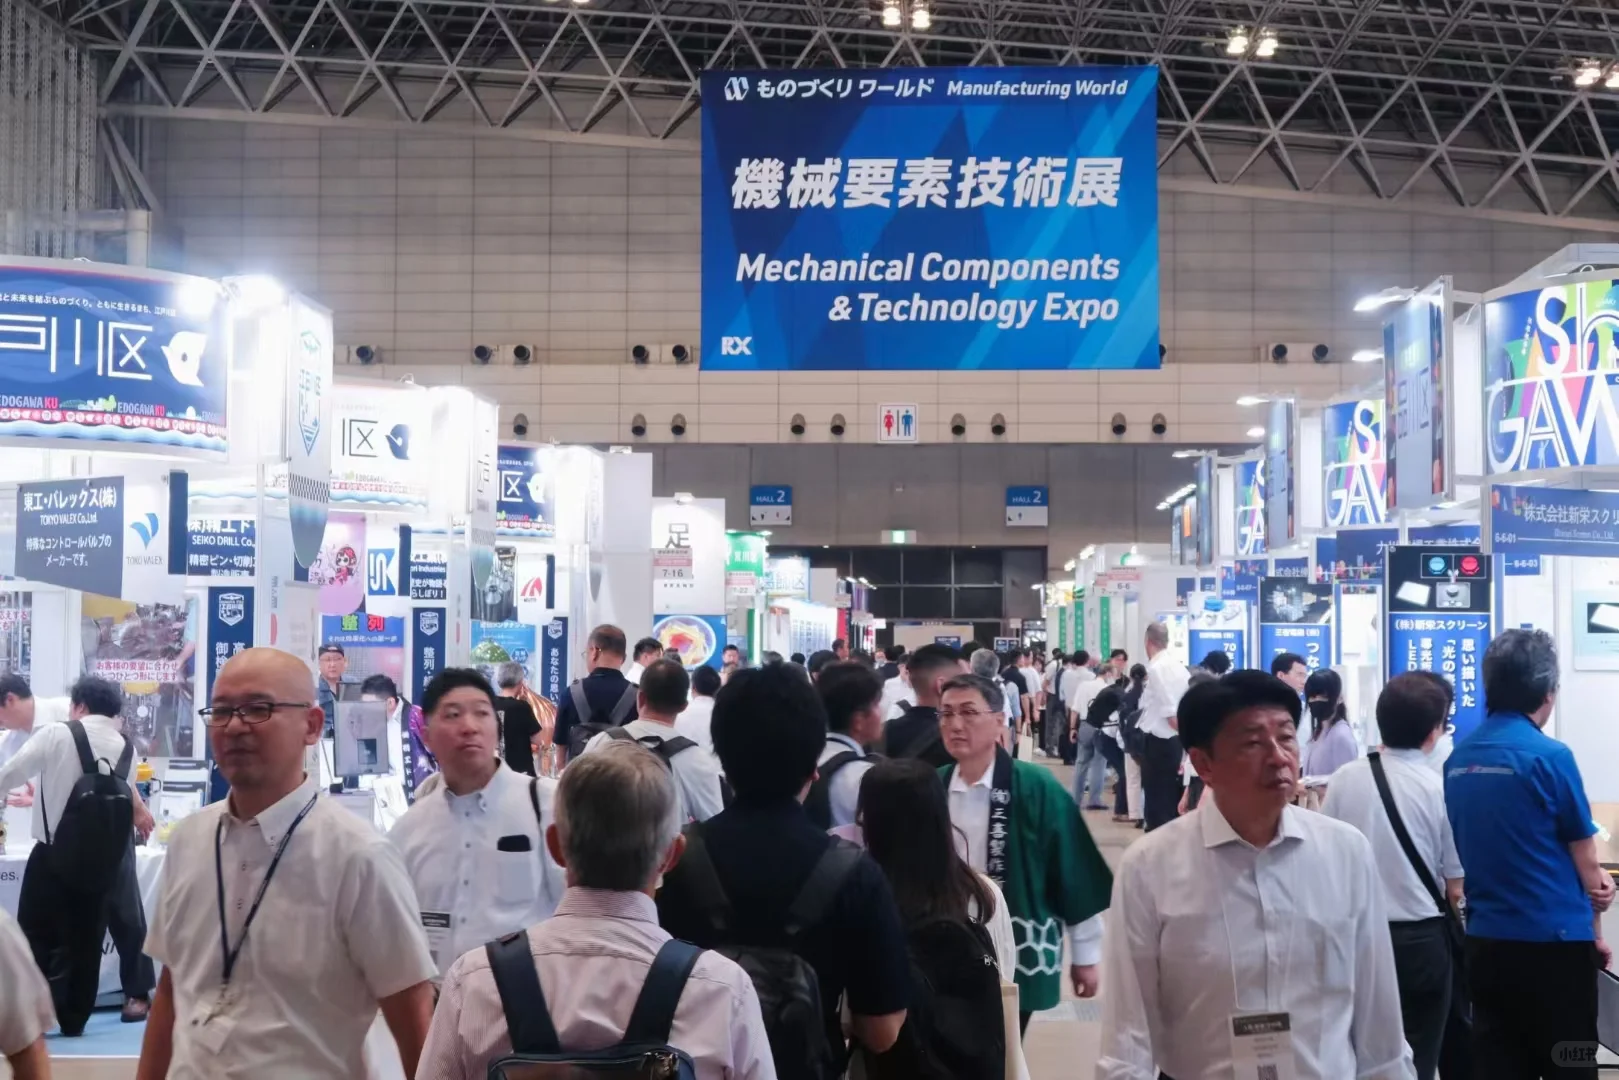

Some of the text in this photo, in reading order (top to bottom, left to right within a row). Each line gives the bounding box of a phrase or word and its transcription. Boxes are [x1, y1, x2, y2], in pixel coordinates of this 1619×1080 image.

[757, 77, 1127, 100] ものづくり ワールド Manufacturing World
[732, 156, 1123, 209] 機械要素技術展
[736, 252, 1120, 288] Mechanical Components
[829, 292, 1119, 329] & Technology Expo
[721, 336, 752, 355] RX
[777, 490, 785, 503] 2
[1033, 491, 1042, 503] 2
[192, 535, 216, 545] SEIKO
[217, 535, 240, 546] DRILL
[665, 522, 691, 549] 足
[663, 569, 684, 578] 7-16
[1461, 638, 1476, 708] 思い描いた
